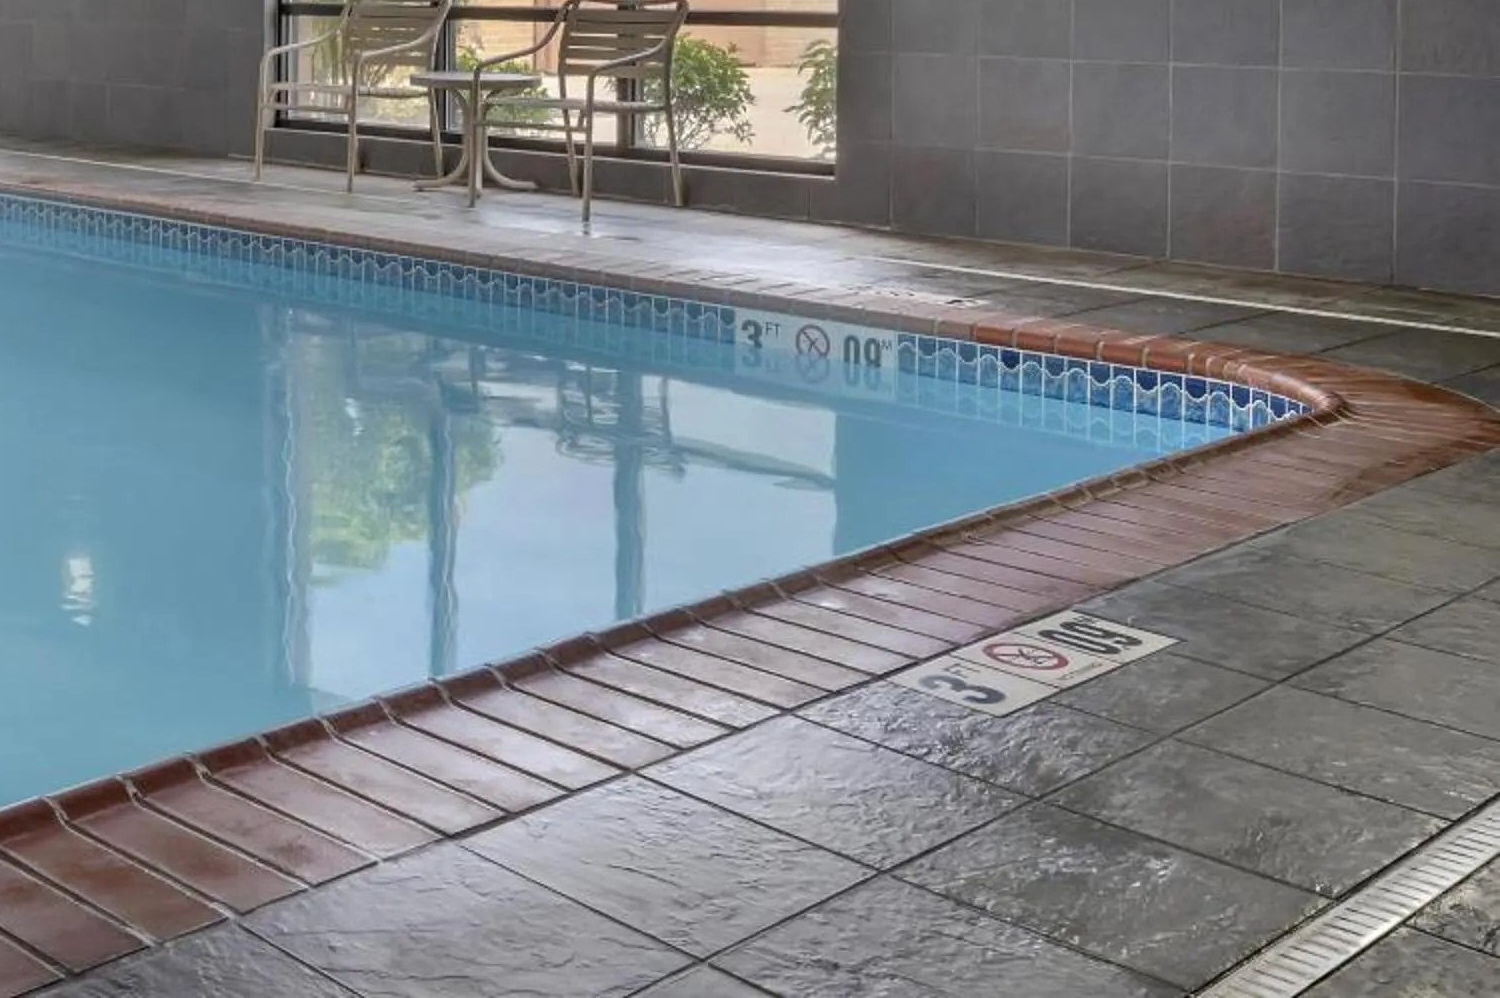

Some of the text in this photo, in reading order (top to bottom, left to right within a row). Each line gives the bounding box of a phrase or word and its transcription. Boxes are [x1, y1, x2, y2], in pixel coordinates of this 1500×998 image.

[741, 319, 763, 349] 3
[765, 321, 781, 338] FT
[919, 674, 1006, 705] 3
